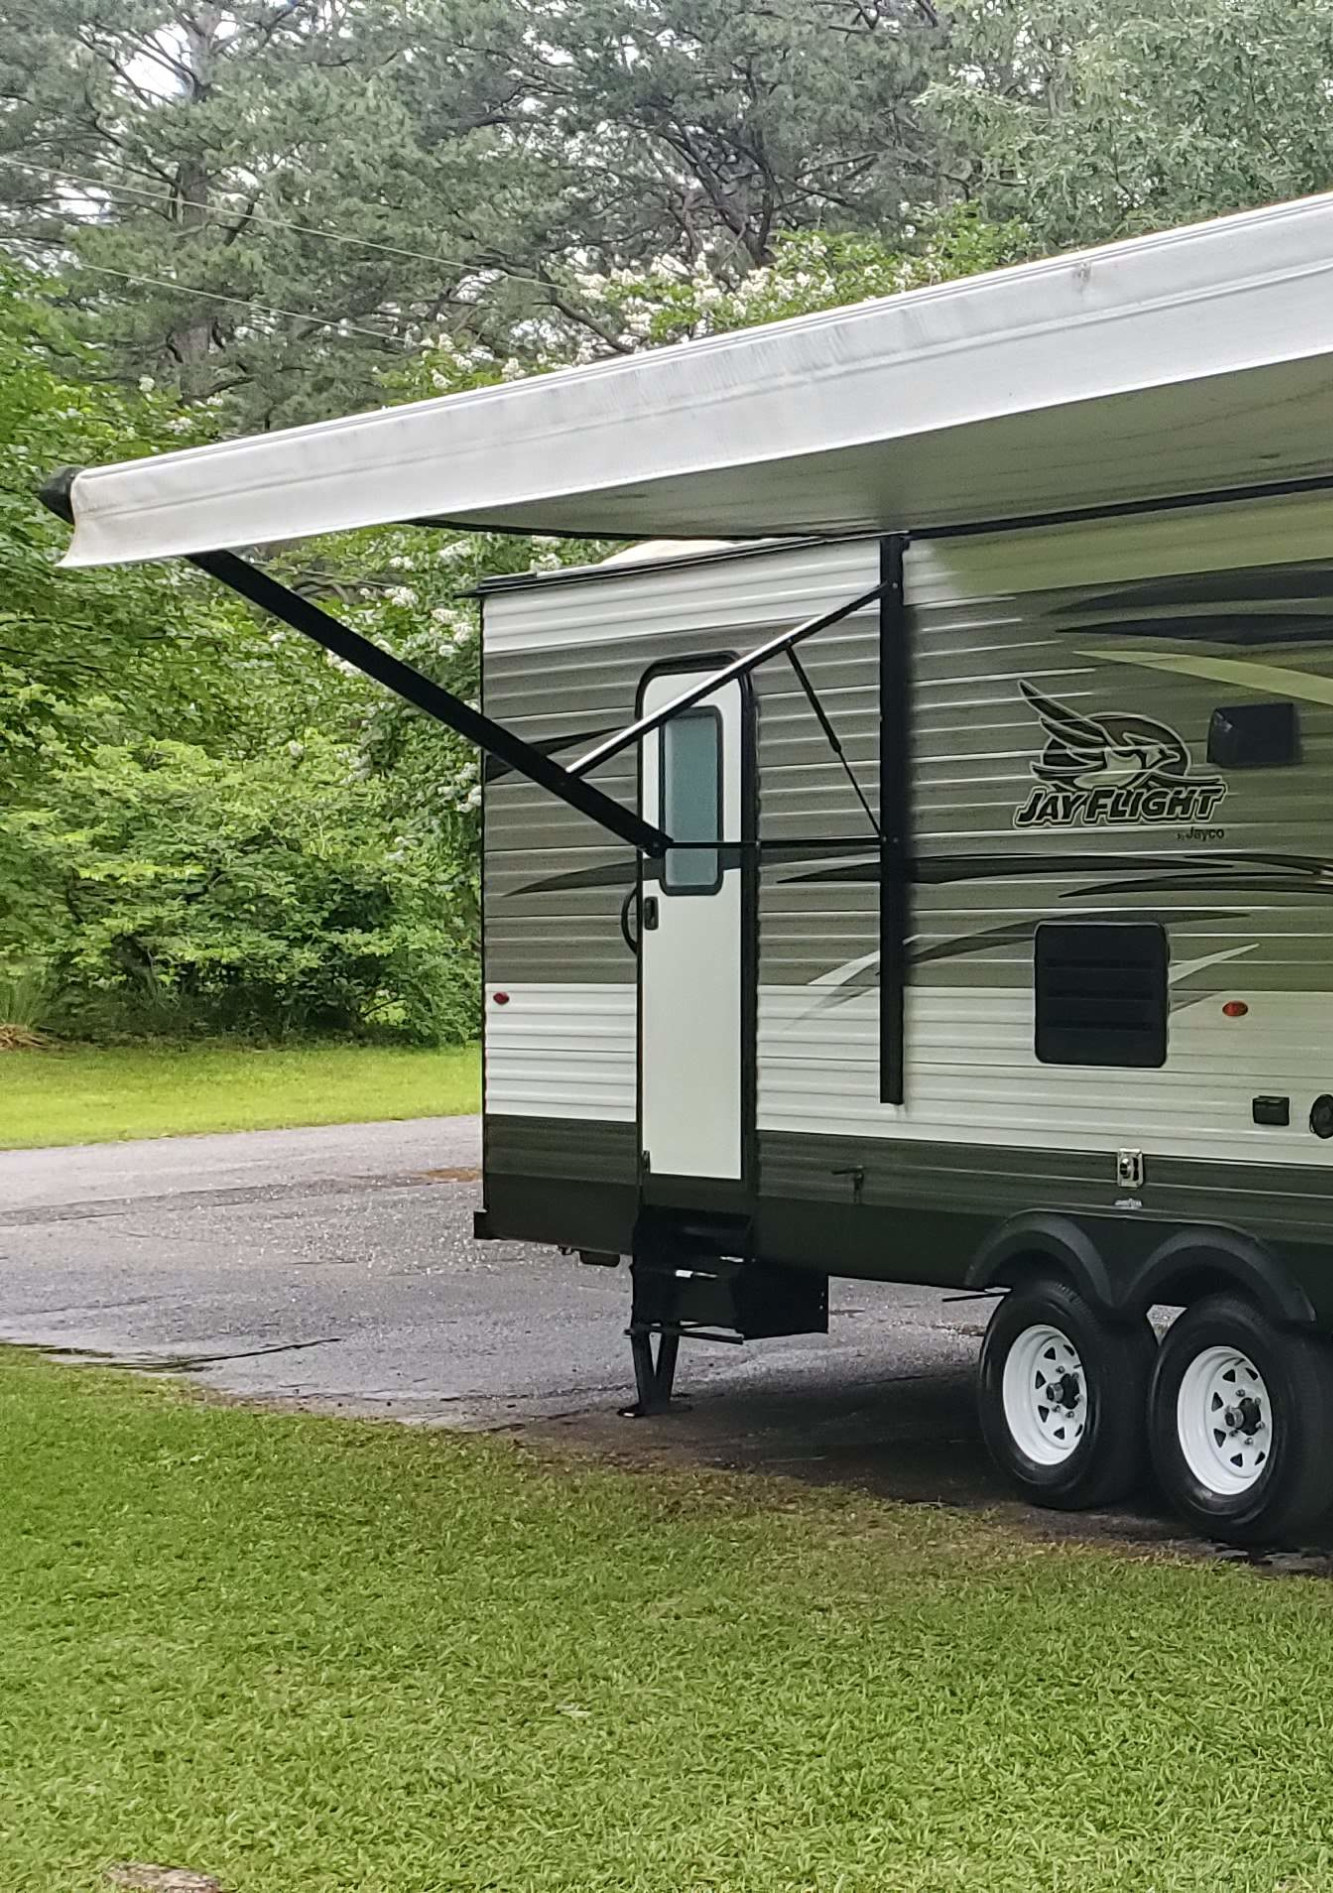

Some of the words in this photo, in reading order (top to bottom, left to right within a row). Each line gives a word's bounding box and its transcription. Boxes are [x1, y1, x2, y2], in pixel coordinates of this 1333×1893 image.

[1013, 785, 1090, 829] JAY
[1082, 783, 1228, 826] FLIGHT
[1185, 826, 1225, 842] Jayco
